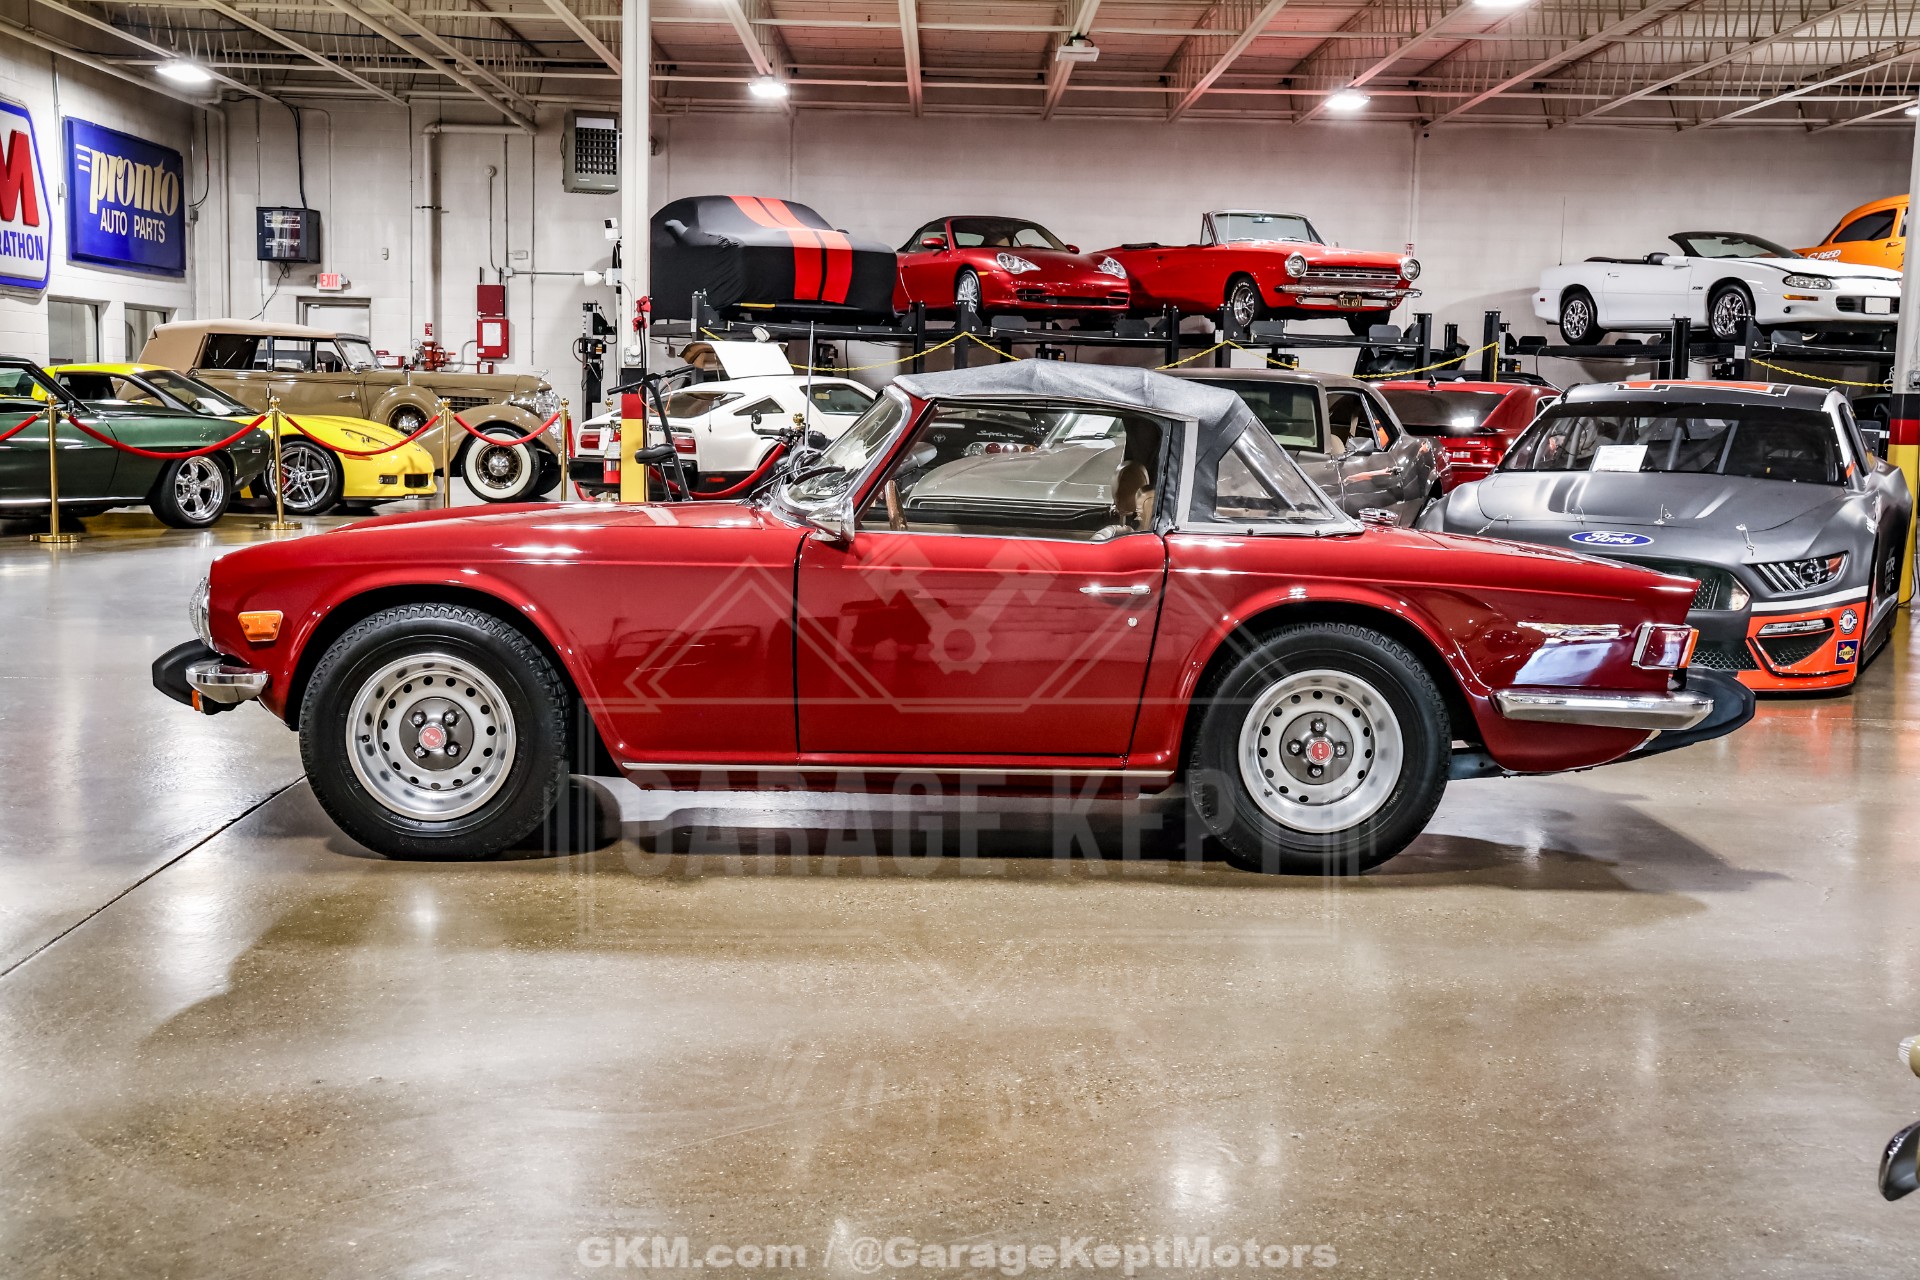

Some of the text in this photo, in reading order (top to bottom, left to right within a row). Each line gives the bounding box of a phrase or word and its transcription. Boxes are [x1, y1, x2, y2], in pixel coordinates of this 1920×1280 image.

[0, 129, 39, 227] M
[90, 149, 179, 216] pronto
[100, 208, 165, 243] AUTO PARTS
[320, 273, 338, 288] EXIT
[1585, 532, 1637, 544] Ford
